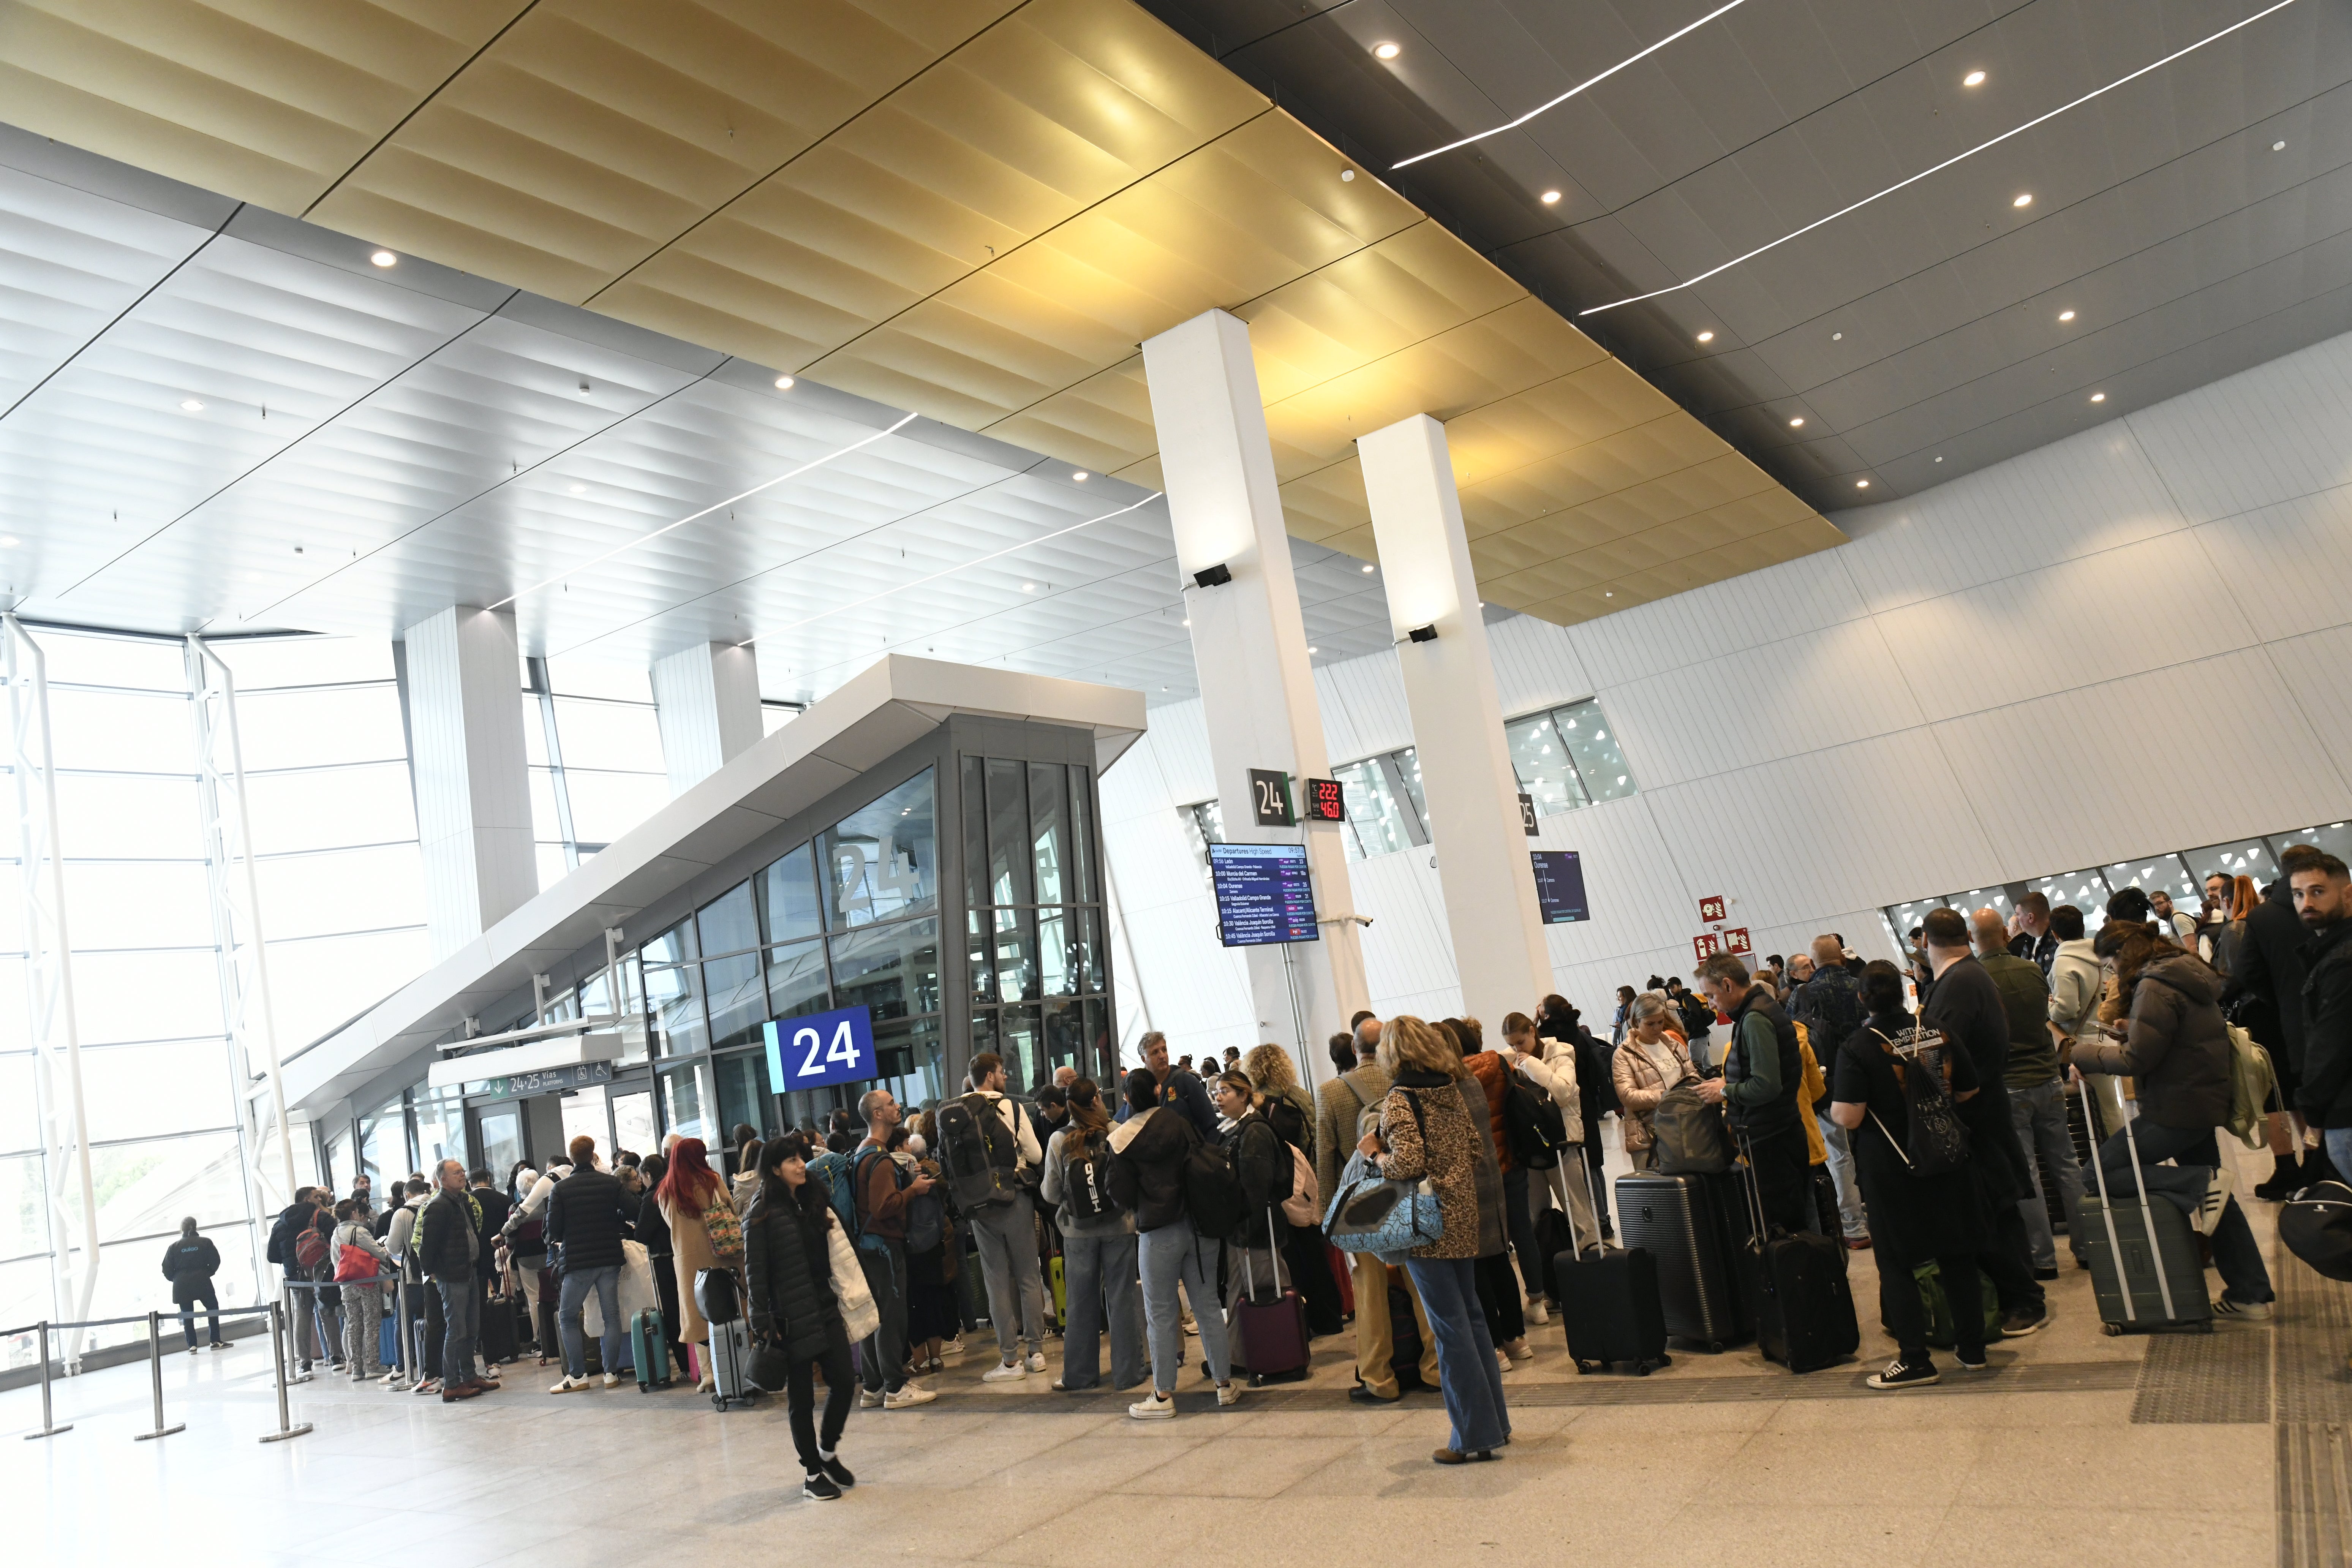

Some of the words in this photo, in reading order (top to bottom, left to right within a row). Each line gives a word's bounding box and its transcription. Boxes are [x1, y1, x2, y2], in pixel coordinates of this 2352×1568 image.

[1256, 780, 1283, 815] 24
[1519, 802, 1534, 827] 25
[833, 835, 920, 913] 24
[793, 1021, 860, 1076] 24
[1896, 1025, 1926, 1037] WITHN
[542, 1071, 556, 1079] Vías
[1085, 1163, 1102, 1212] HEAD
